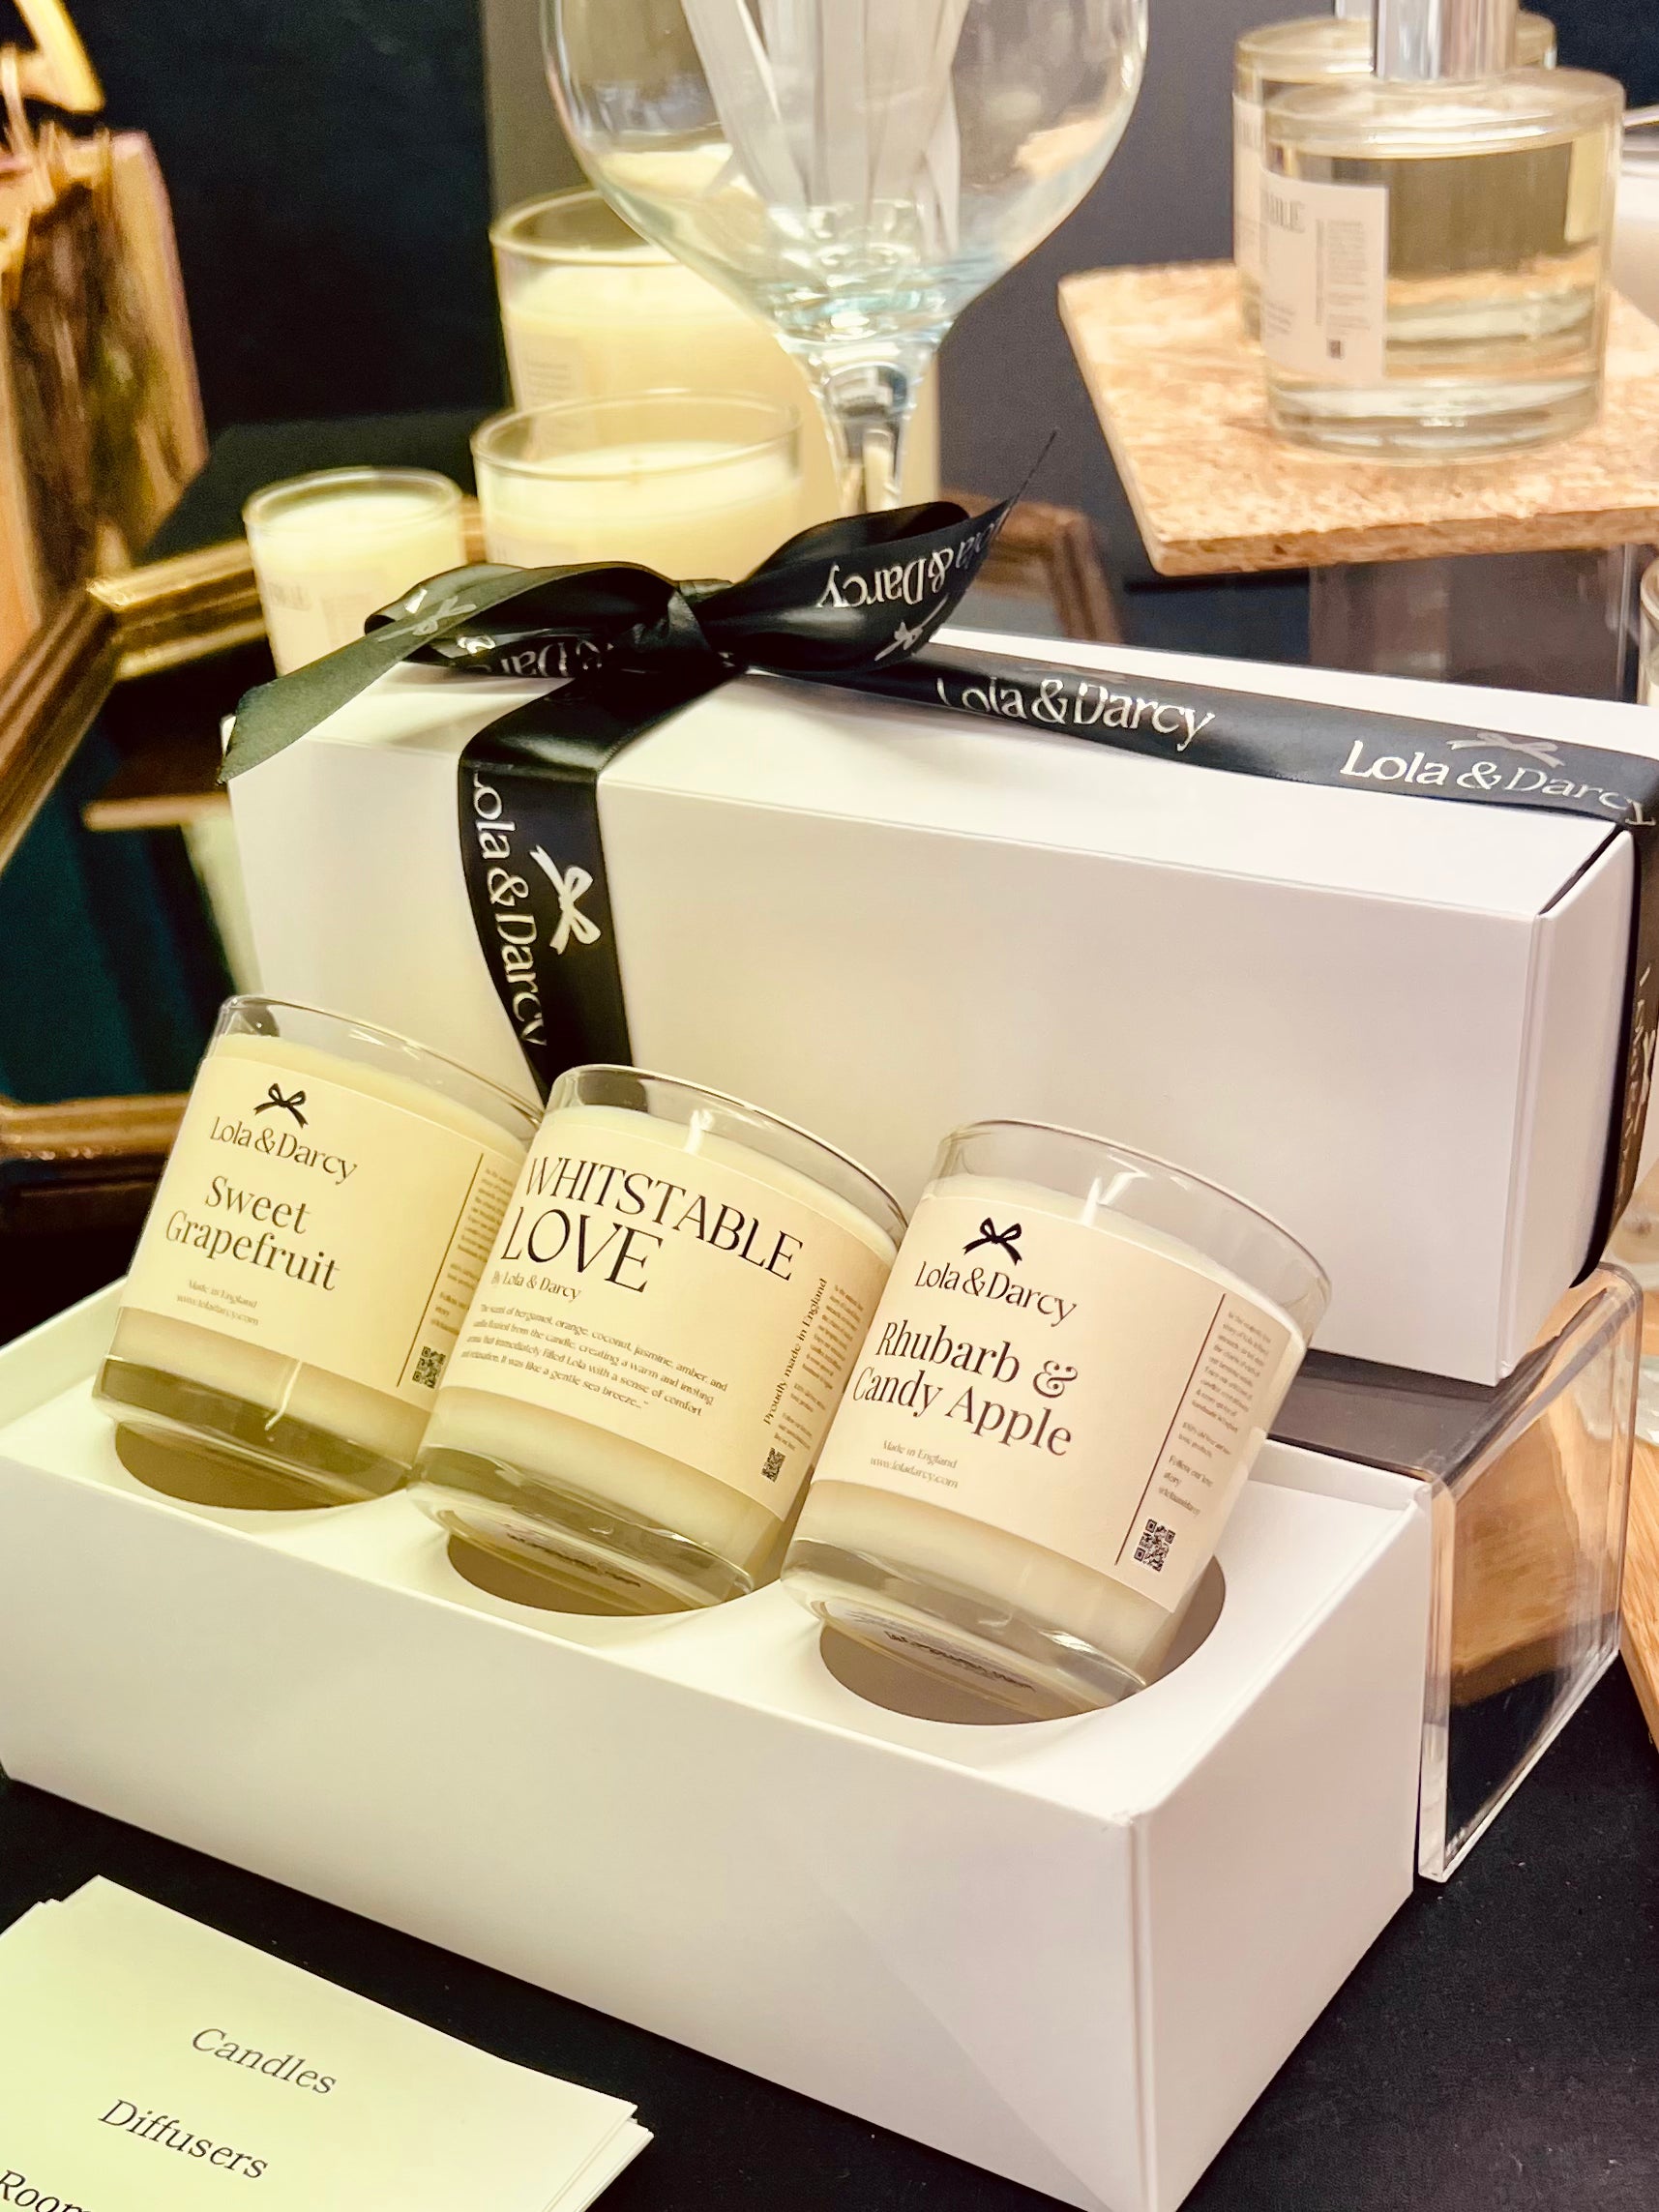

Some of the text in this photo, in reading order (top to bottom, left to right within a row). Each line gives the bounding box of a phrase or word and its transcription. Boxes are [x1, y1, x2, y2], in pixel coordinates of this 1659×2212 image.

[204, 1175, 311, 1235] Sweet
[525, 1156, 804, 1282] WHITSTABLE
[165, 1210, 341, 1291] Grapefruit
[500, 1206, 664, 1293] LOVE
[503, 1271, 524, 1286] Lola
[526, 1275, 538, 1289] &
[539, 1277, 581, 1303] Darcy
[549, 1371, 581, 1386] gentle
[582, 1380, 601, 1392] sea
[578, 1344, 620, 1367] creating
[630, 1362, 659, 1379] warm
[660, 1373, 680, 1387] and
[710, 1378, 728, 1392] and
[763, 1278, 828, 1425] Proudly made in England
[874, 1319, 1021, 1383] Rhubarb
[1032, 1360, 1079, 1399] &
[566, 1356, 587, 1370] Lola
[588, 1365, 610, 1378] with
[620, 1376, 650, 1394] sense
[651, 1389, 664, 1399] of
[664, 1394, 702, 1417] comfort
[852, 1366, 944, 1418] Candy
[944, 1385, 1072, 1457] Apple
[883, 1439, 905, 1454] Made
[917, 1448, 958, 1469] England
[192, 2027, 337, 2095] Candles
[98, 2099, 268, 2179] Diffusers
